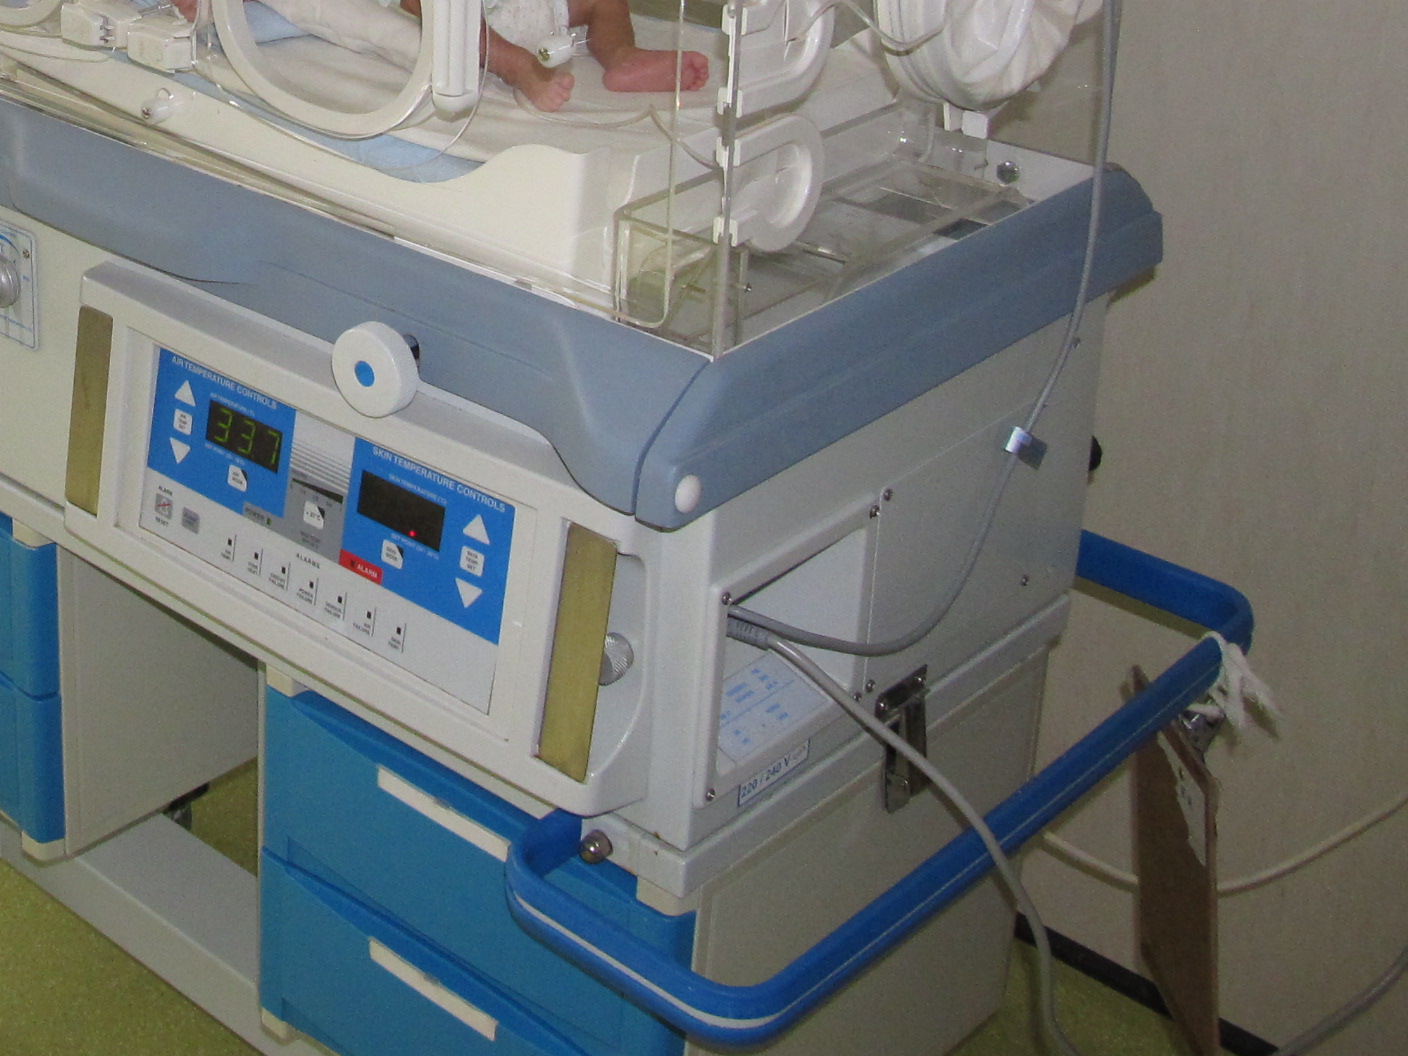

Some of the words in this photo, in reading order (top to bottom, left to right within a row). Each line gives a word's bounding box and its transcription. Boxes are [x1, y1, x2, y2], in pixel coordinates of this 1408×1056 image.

[172, 356, 183, 368] AIR
[183, 361, 235, 391] TEMPERATURE
[236, 385, 278, 410] CONTROLS
[372, 446, 392, 462] SKIN
[393, 454, 455, 490] TEMPERATURE
[456, 484, 506, 514] CONTROLS
[295, 553, 321, 569] ALARMS
[357, 564, 378, 579] ALARM
[740, 779, 758, 800] 220
[765, 763, 782, 782] 240
